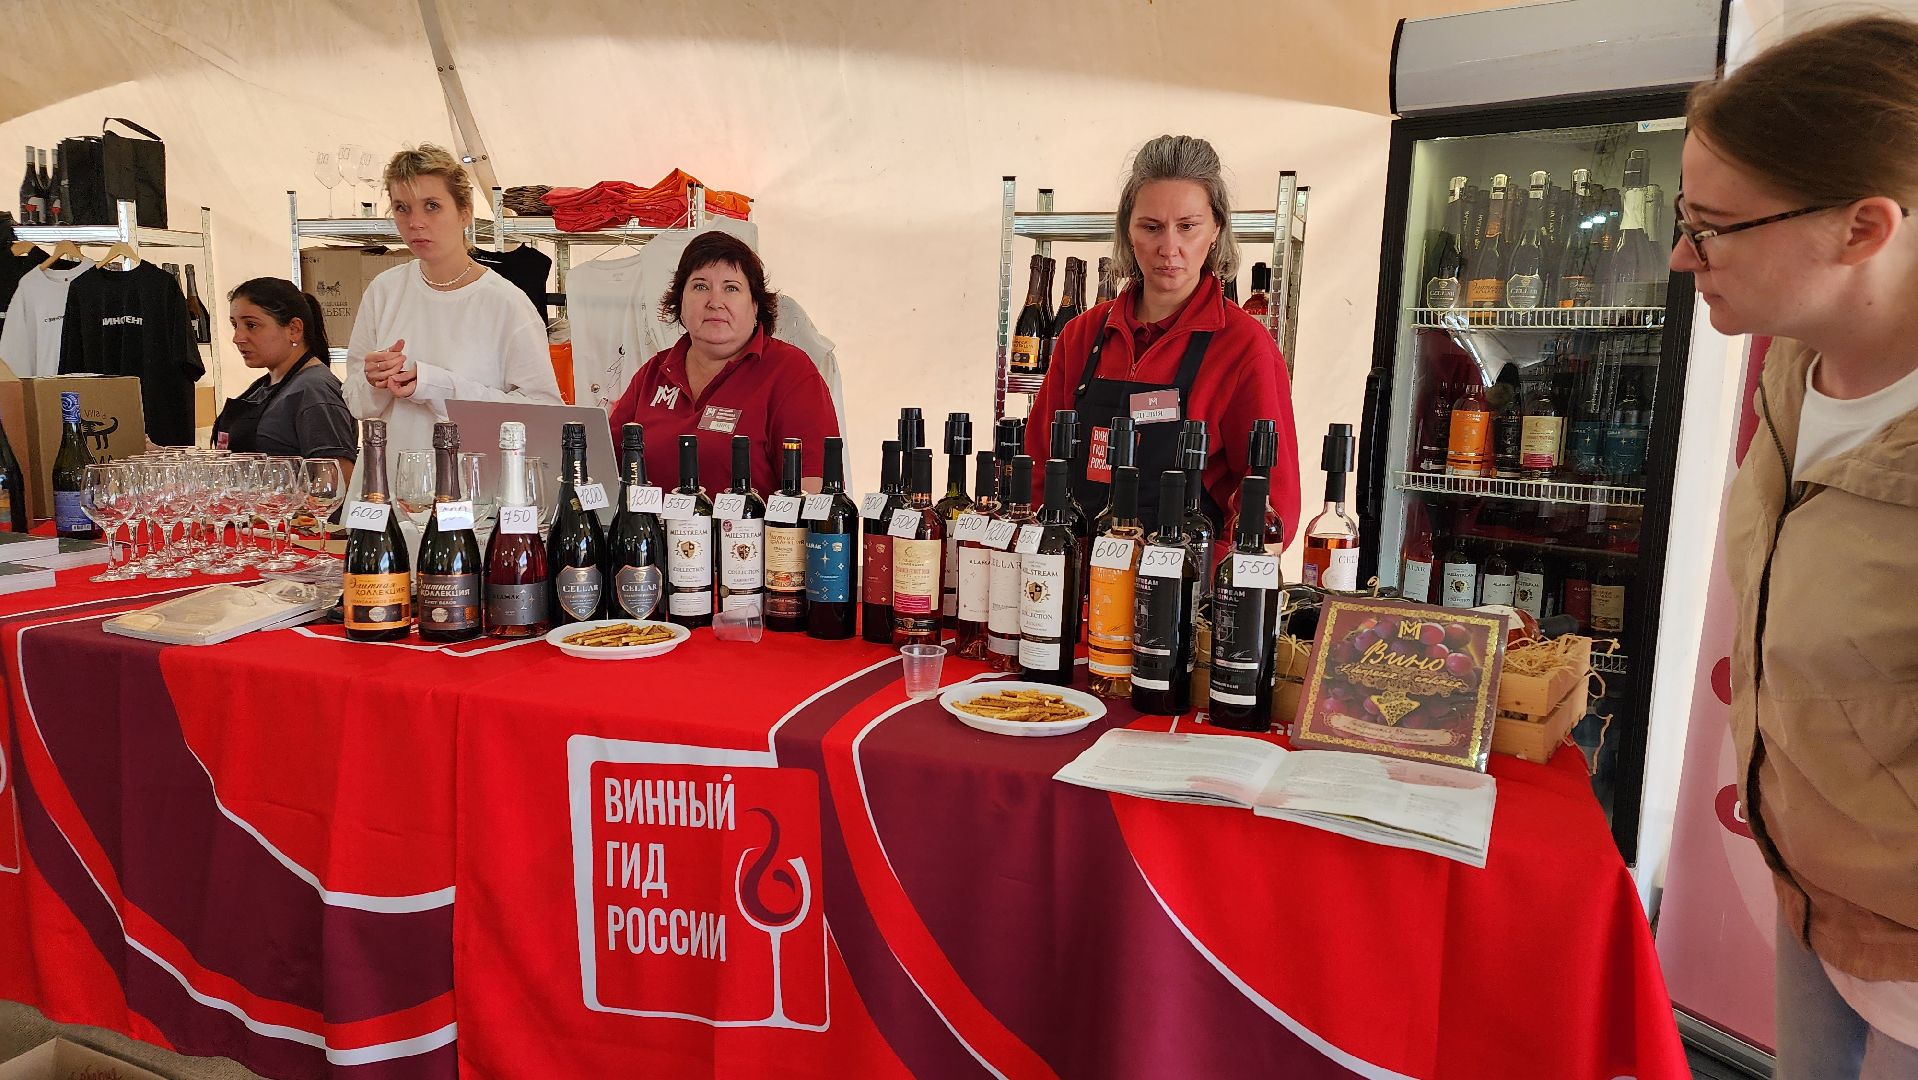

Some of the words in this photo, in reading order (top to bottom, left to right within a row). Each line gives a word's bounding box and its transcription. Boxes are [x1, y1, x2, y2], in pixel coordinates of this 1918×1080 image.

[1093, 430, 1108, 443] ВИН
[580, 486, 603, 505] 1200
[631, 488, 659, 506] 1200
[665, 498, 691, 510] 550
[716, 498, 742, 512] 550
[768, 499, 793, 512] 600
[807, 496, 830, 511] 700
[350, 506, 383, 520] 600
[503, 509, 531, 524] 750
[892, 514, 917, 530] 500
[958, 516, 982, 531] 700
[1095, 540, 1128, 558] 600
[1144, 550, 1181, 566] 550
[1237, 560, 1275, 576] 550
[420, 588, 470, 597] КОЛЛЕКЦИЯ
[562, 584, 599, 594] CELLAR
[621, 584, 657, 593] CELLAR
[603, 773, 736, 831] ВИННЫЙ
[606, 841, 668, 899] ГИД
[607, 905, 727, 962] РОССИИ
